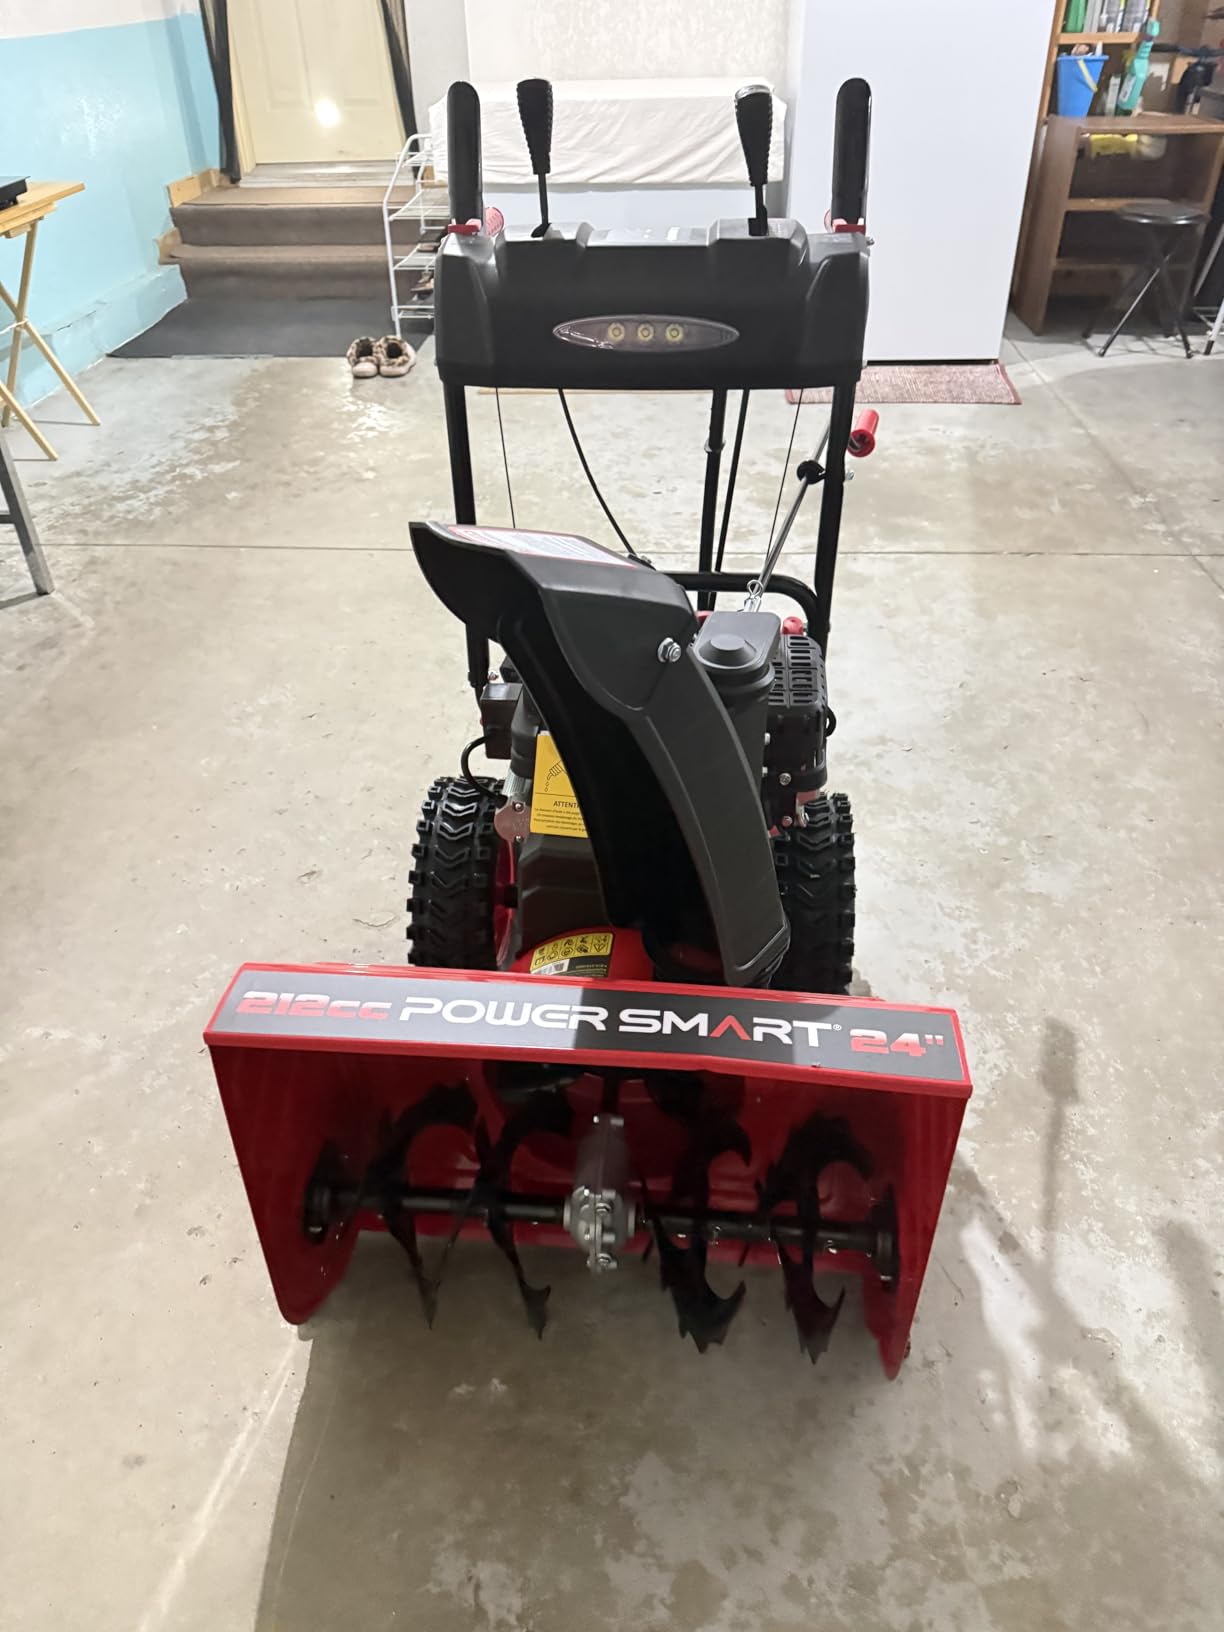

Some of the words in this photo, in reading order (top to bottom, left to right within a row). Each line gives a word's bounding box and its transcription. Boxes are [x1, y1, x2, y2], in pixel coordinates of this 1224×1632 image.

[236, 990, 393, 1020] 212cc
[399, 996, 609, 1031] POWER
[849, 1028, 944, 1057] 24"
